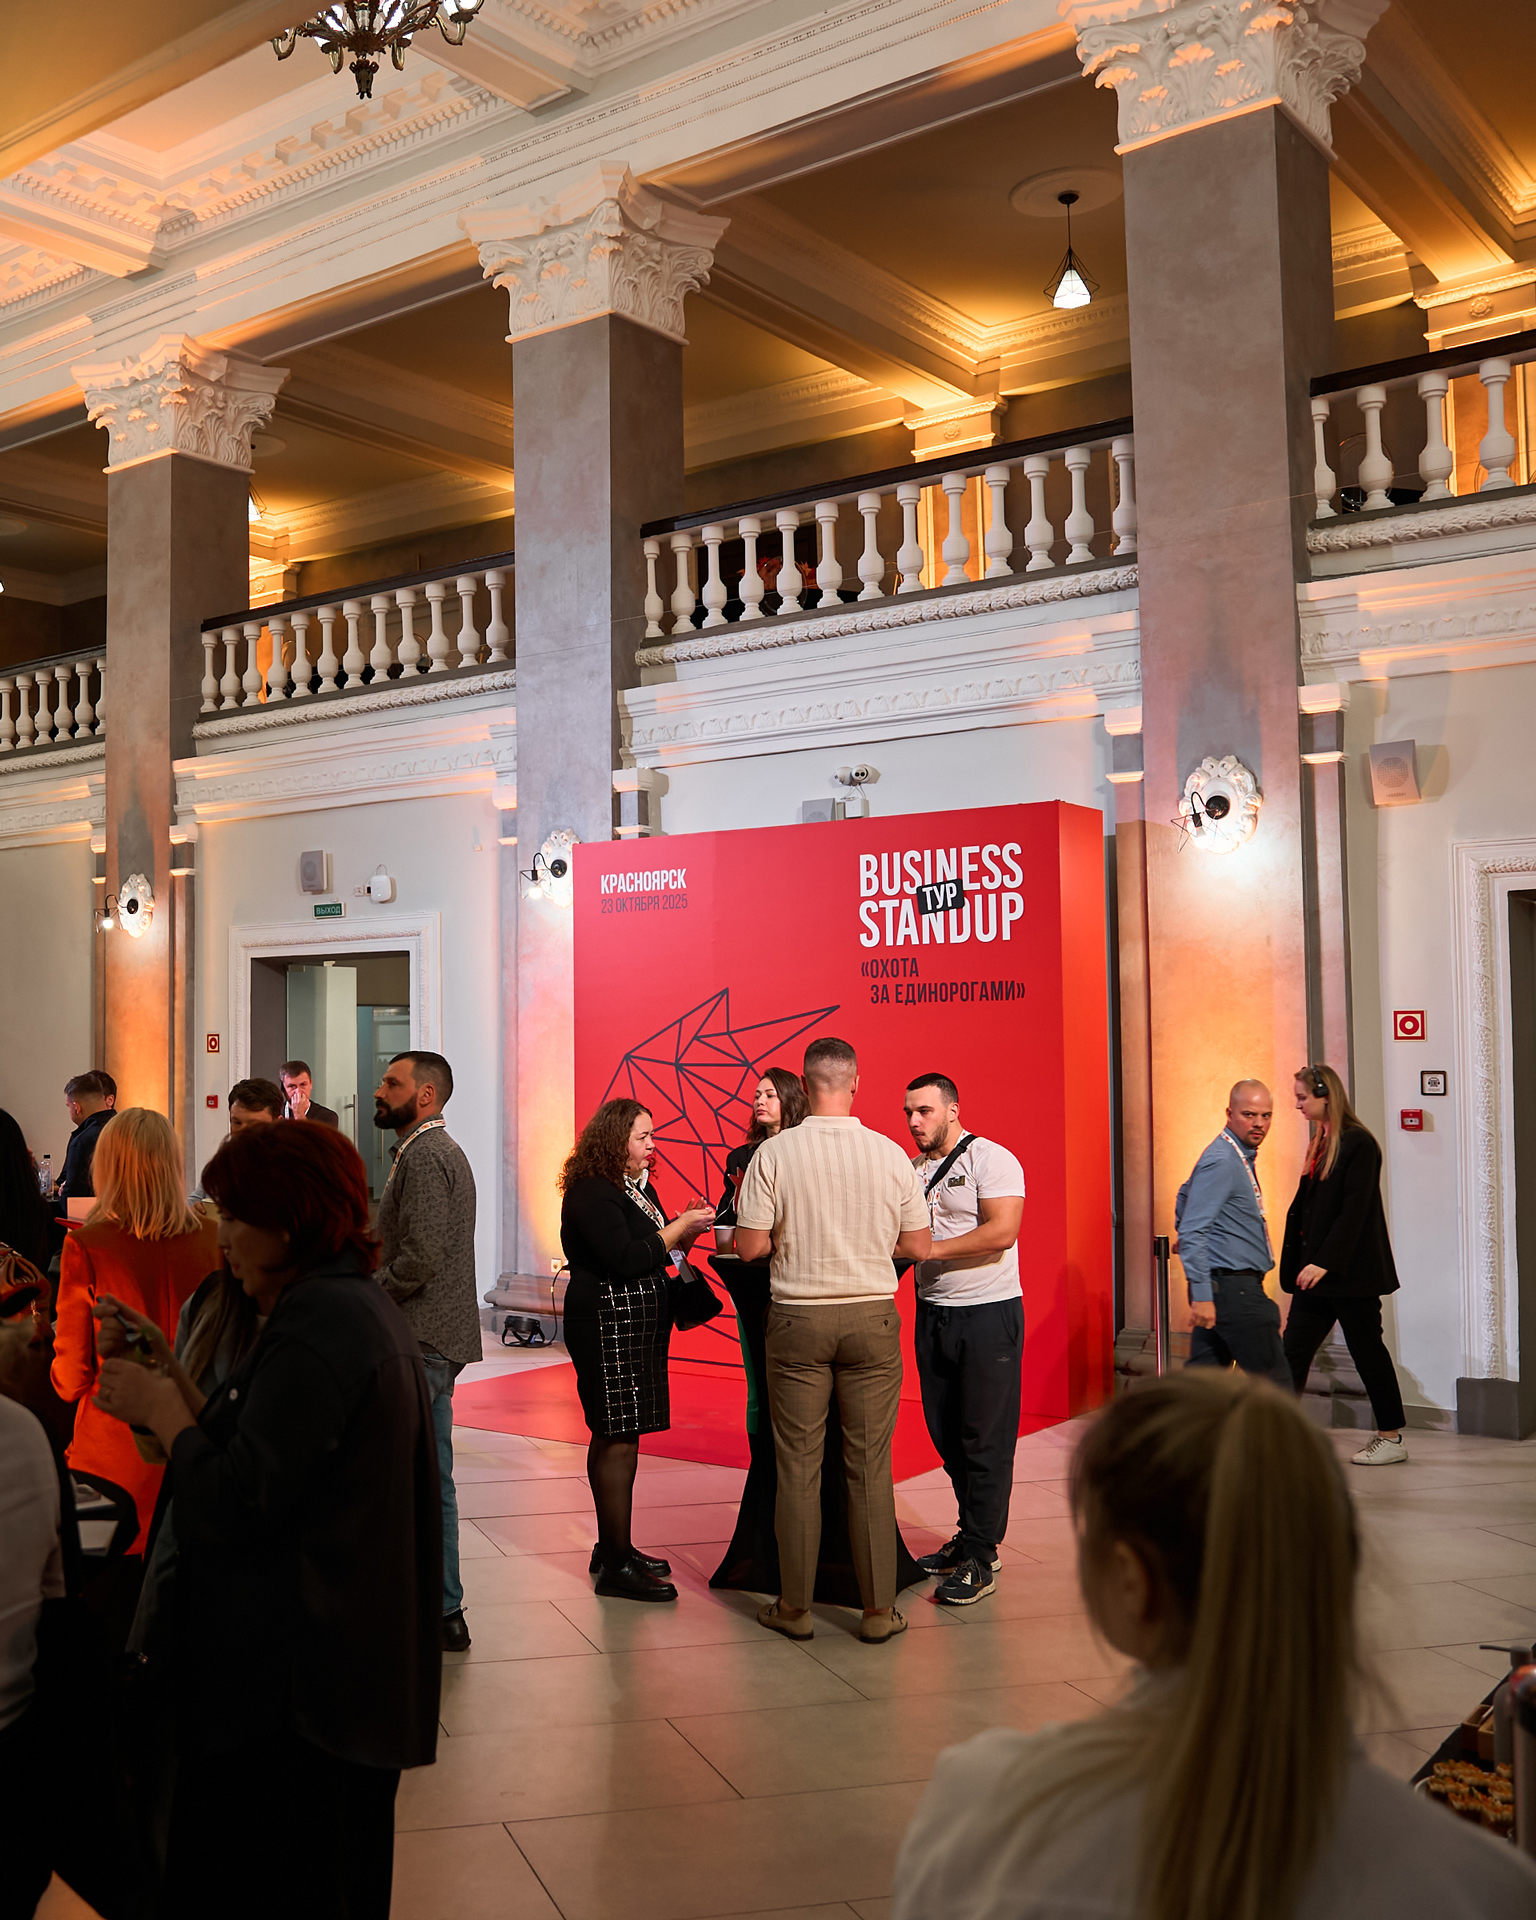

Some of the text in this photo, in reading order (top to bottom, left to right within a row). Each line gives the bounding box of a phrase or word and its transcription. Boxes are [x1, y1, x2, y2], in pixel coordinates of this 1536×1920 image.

[600, 868, 687, 895] КРАСНОЯРСК
[859, 842, 1024, 898] BUSINESS
[601, 893, 688, 914] 23 ОКТЯБРЯ 2025
[922, 882, 958, 911] ТУР
[316, 906, 340, 914] ВЫХОД
[858, 891, 1025, 948] STANDUP
[861, 957, 920, 979] «ОХОТА
[870, 981, 1026, 1006] ЗА ЕДИНОРОГАМИ»
